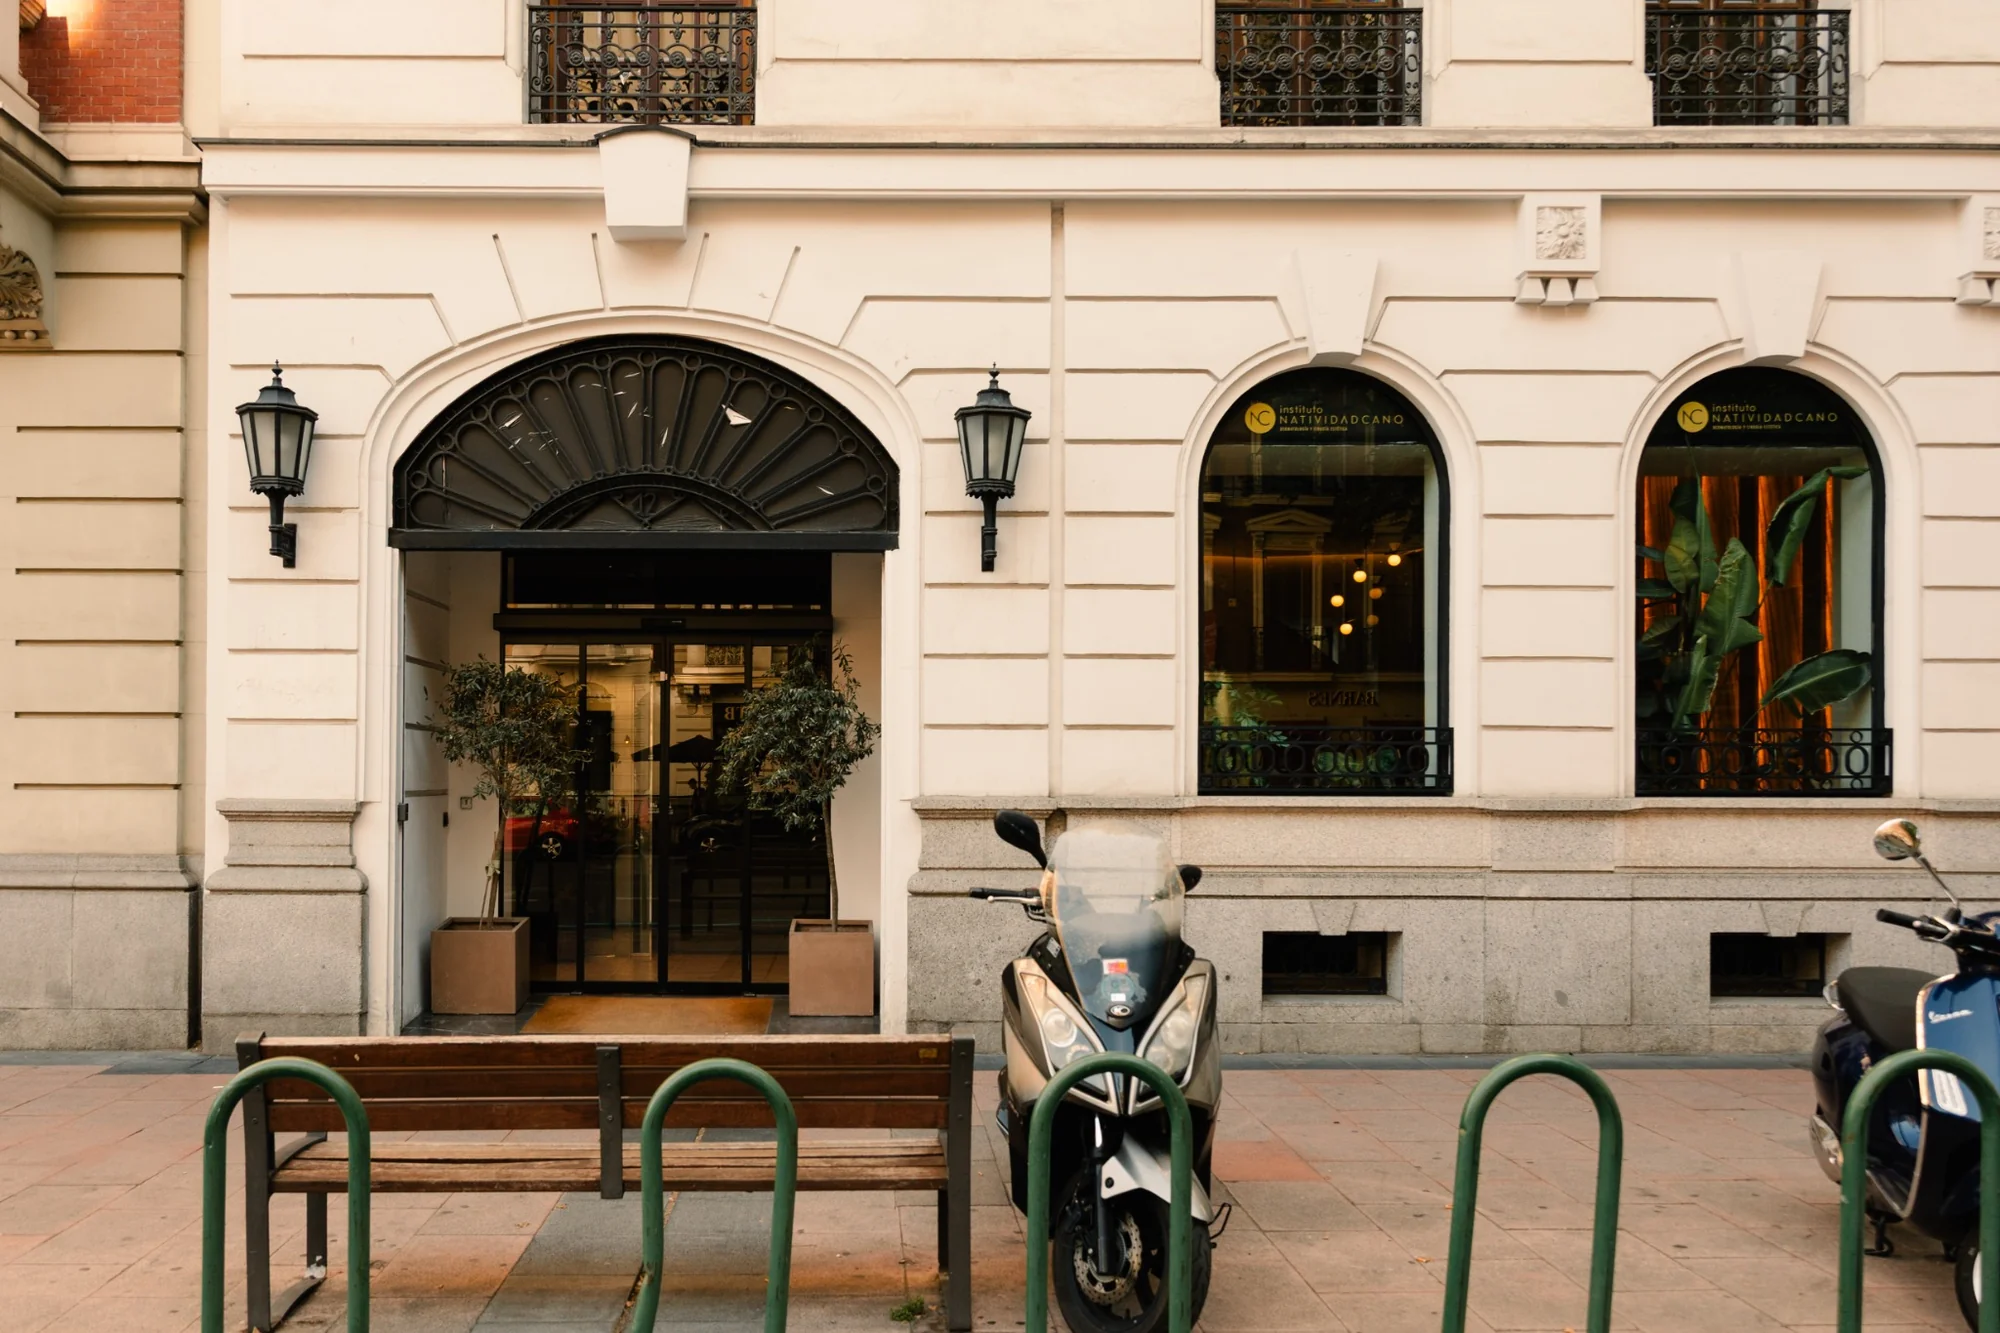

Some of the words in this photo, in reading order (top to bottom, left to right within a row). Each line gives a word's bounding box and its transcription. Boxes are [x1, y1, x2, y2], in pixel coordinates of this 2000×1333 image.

[1279, 405, 1323, 414] instituto
[1712, 403, 1756, 412] instituto
[1279, 414, 1404, 424] NATIVIDADCANO
[1712, 412, 1838, 423] NATIVIDADCANO
